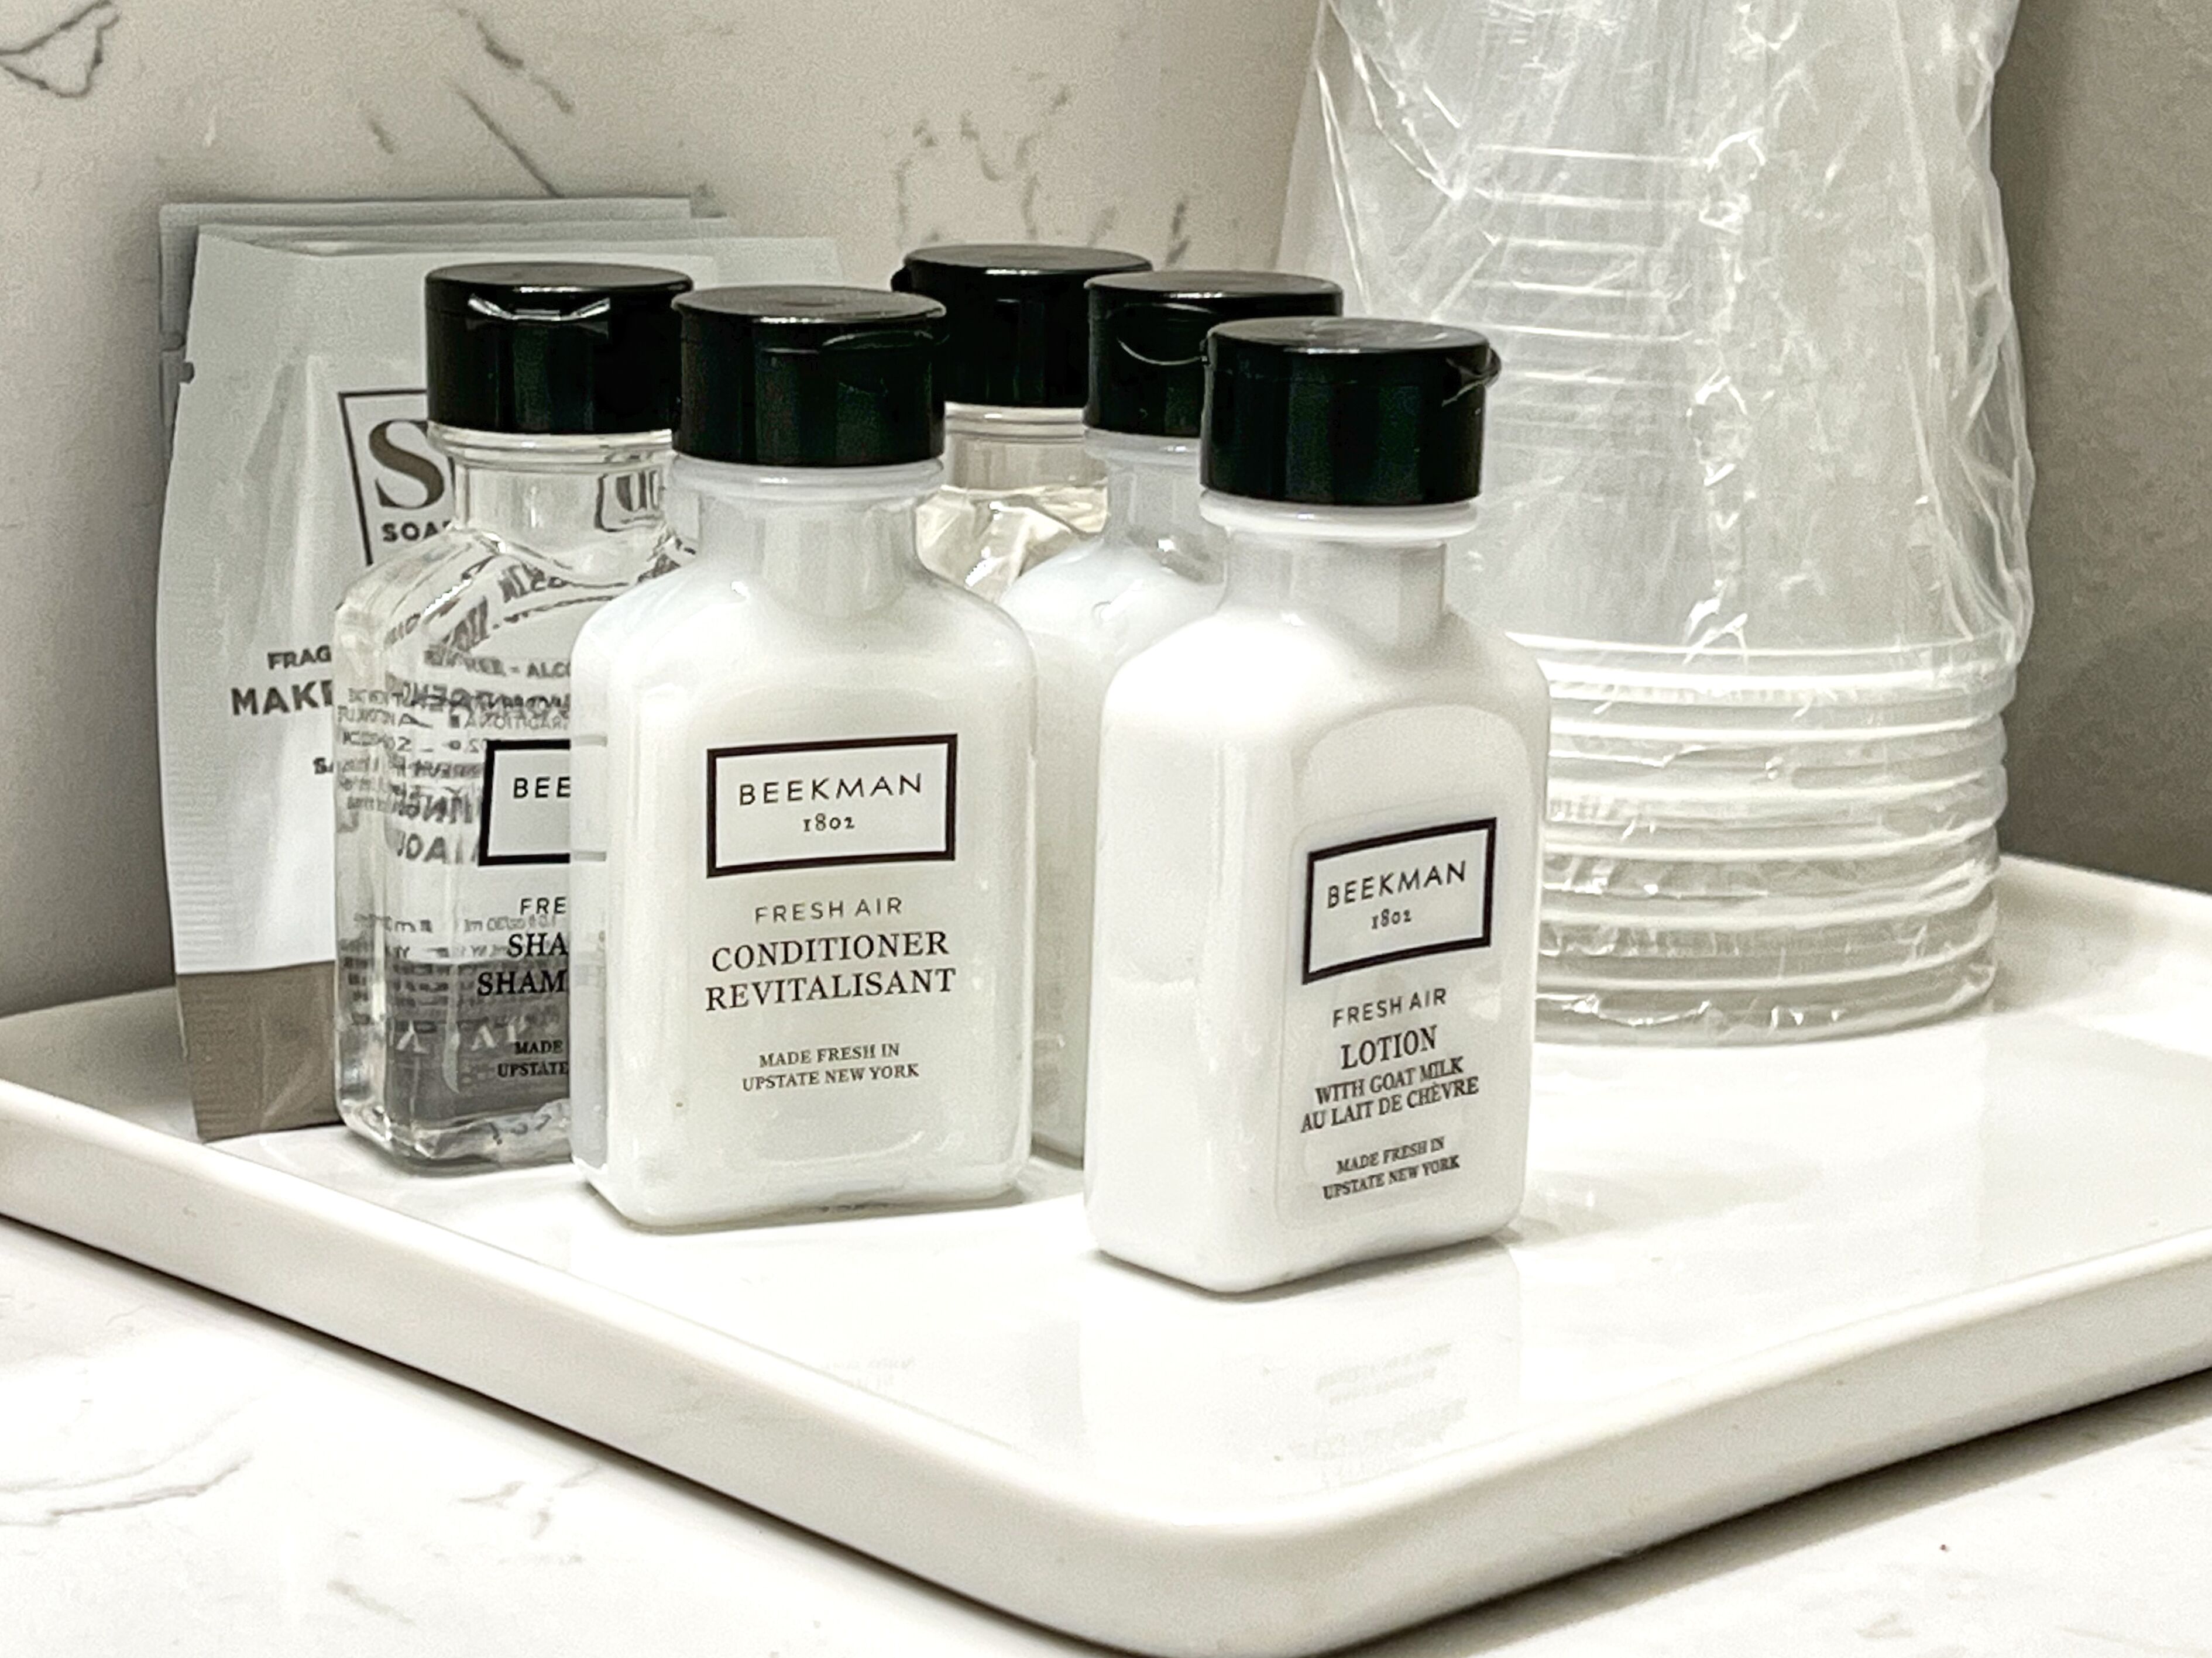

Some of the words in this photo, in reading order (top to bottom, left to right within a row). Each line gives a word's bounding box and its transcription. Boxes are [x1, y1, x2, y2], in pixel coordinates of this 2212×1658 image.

[382, 521, 451, 542] SOA
[513, 776, 571, 799] BEE
[739, 773, 921, 806] BEEKMAN
[803, 813, 855, 832] 1802
[1327, 860, 1466, 909] BEEKMAN
[520, 896, 567, 915] FRE
[755, 900, 844, 924] FRESH
[854, 897, 902, 917] AIR
[1371, 908, 1412, 930] 1802
[507, 932, 569, 958] SHA
[712, 931, 949, 972] CONDITIONER
[477, 969, 568, 996] SHAM
[705, 968, 956, 1012] REVITALISANT
[1332, 996, 1403, 1028] FRESH
[1409, 988, 1447, 1011] AIR
[515, 1039, 564, 1055] MADE
[759, 1049, 812, 1068] MADE
[817, 1044, 876, 1063] FRESH
[881, 1043, 899, 1057] IN
[1341, 1024, 1437, 1070] LOTION
[743, 1071, 820, 1092] UPSTATE
[825, 1067, 865, 1084] NEW
[868, 1063, 919, 1080] YORK
[1315, 1078, 1365, 1105] WITH
[1369, 1067, 1416, 1093] GOAT
[1419, 1055, 1464, 1082] MILK
[1300, 1109, 1327, 1133] AU
[1331, 1100, 1375, 1126] LAIT
[1378, 1093, 1403, 1116] DE
[1406, 1075, 1479, 1109] CHÈVRE
[1336, 1151, 1379, 1175] MADE
[1383, 1140, 1428, 1164] FRESH
[1430, 1136, 1445, 1153] IN
[1322, 1172, 1385, 1200] UPSTATE
[1389, 1165, 1420, 1185] NEW
[1421, 1154, 1460, 1177] YORK
